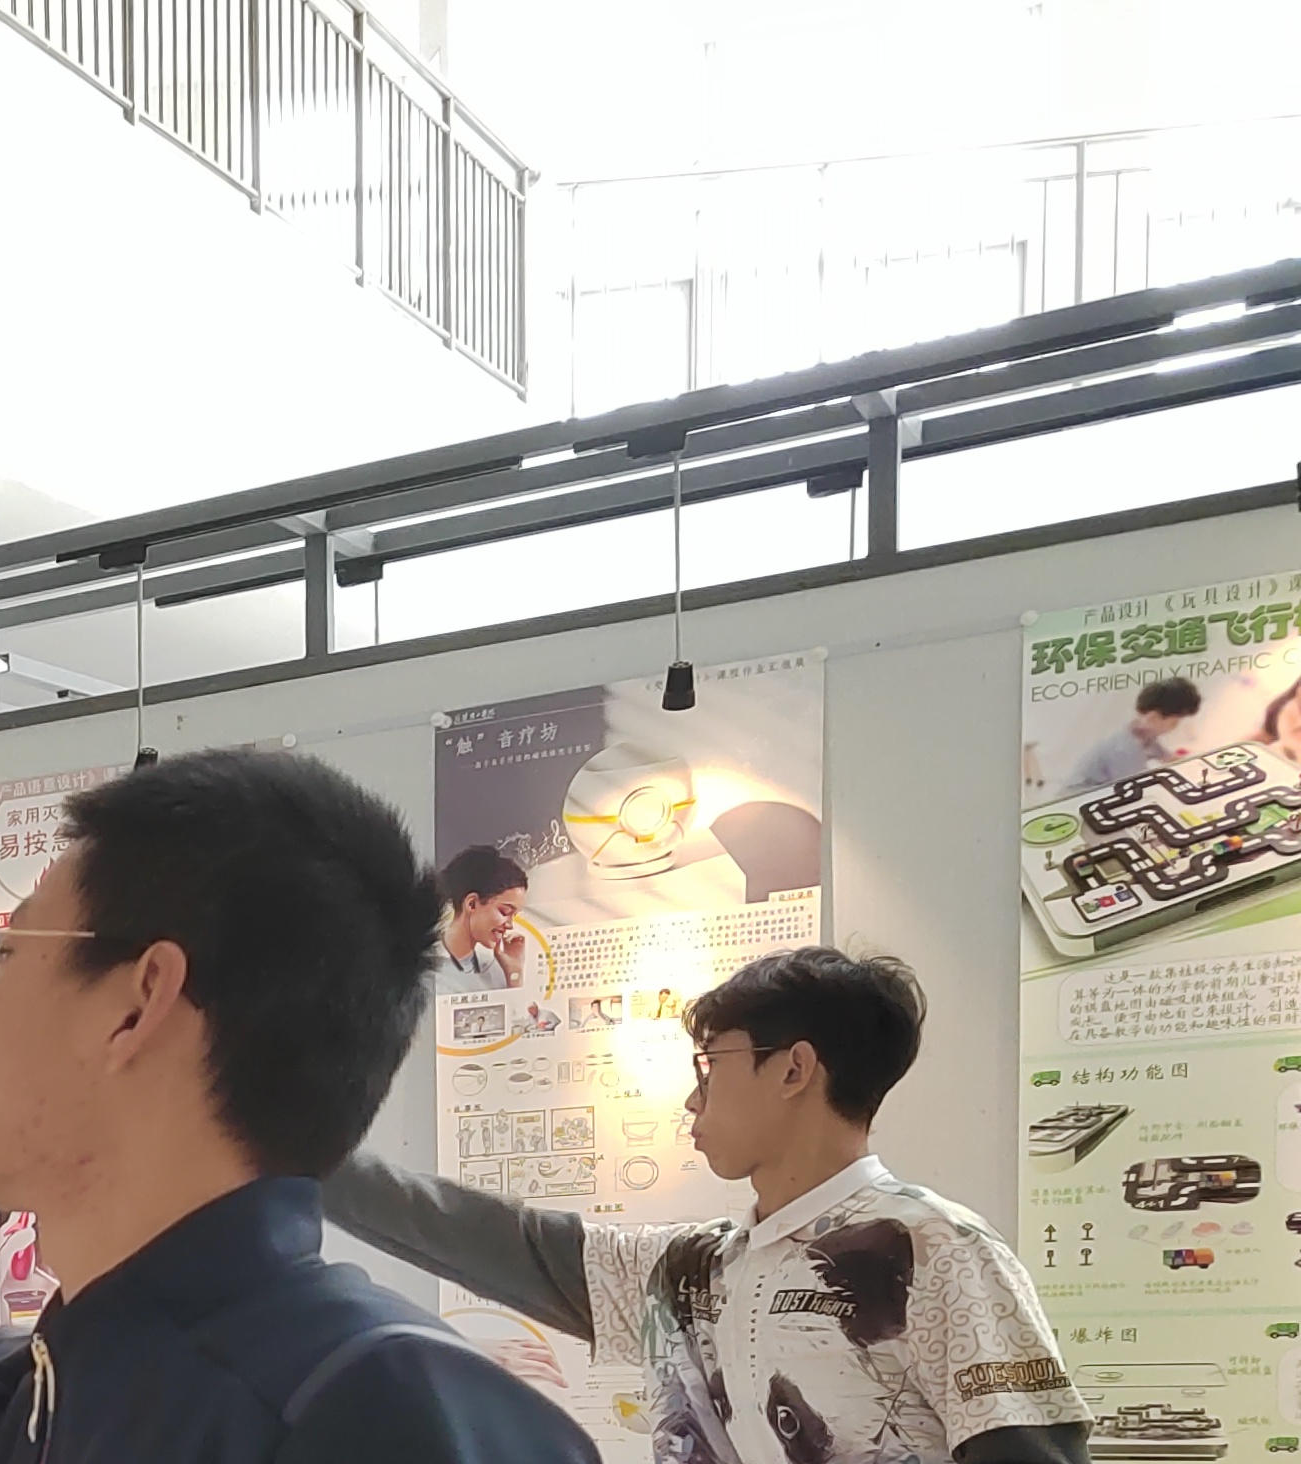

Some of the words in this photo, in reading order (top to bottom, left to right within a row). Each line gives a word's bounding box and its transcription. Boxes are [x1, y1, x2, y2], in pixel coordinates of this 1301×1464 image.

[1083, 599, 1148, 627] 产品设计
[1030, 600, 1301, 676] 环保交通飞行
[1187, 651, 1273, 680] TRAFFIC
[1071, 1062, 1189, 1086] 结构功能图
[1070, 1327, 1139, 1345] 爆炸图
[953, 1358, 1069, 1393] CUESOUL
